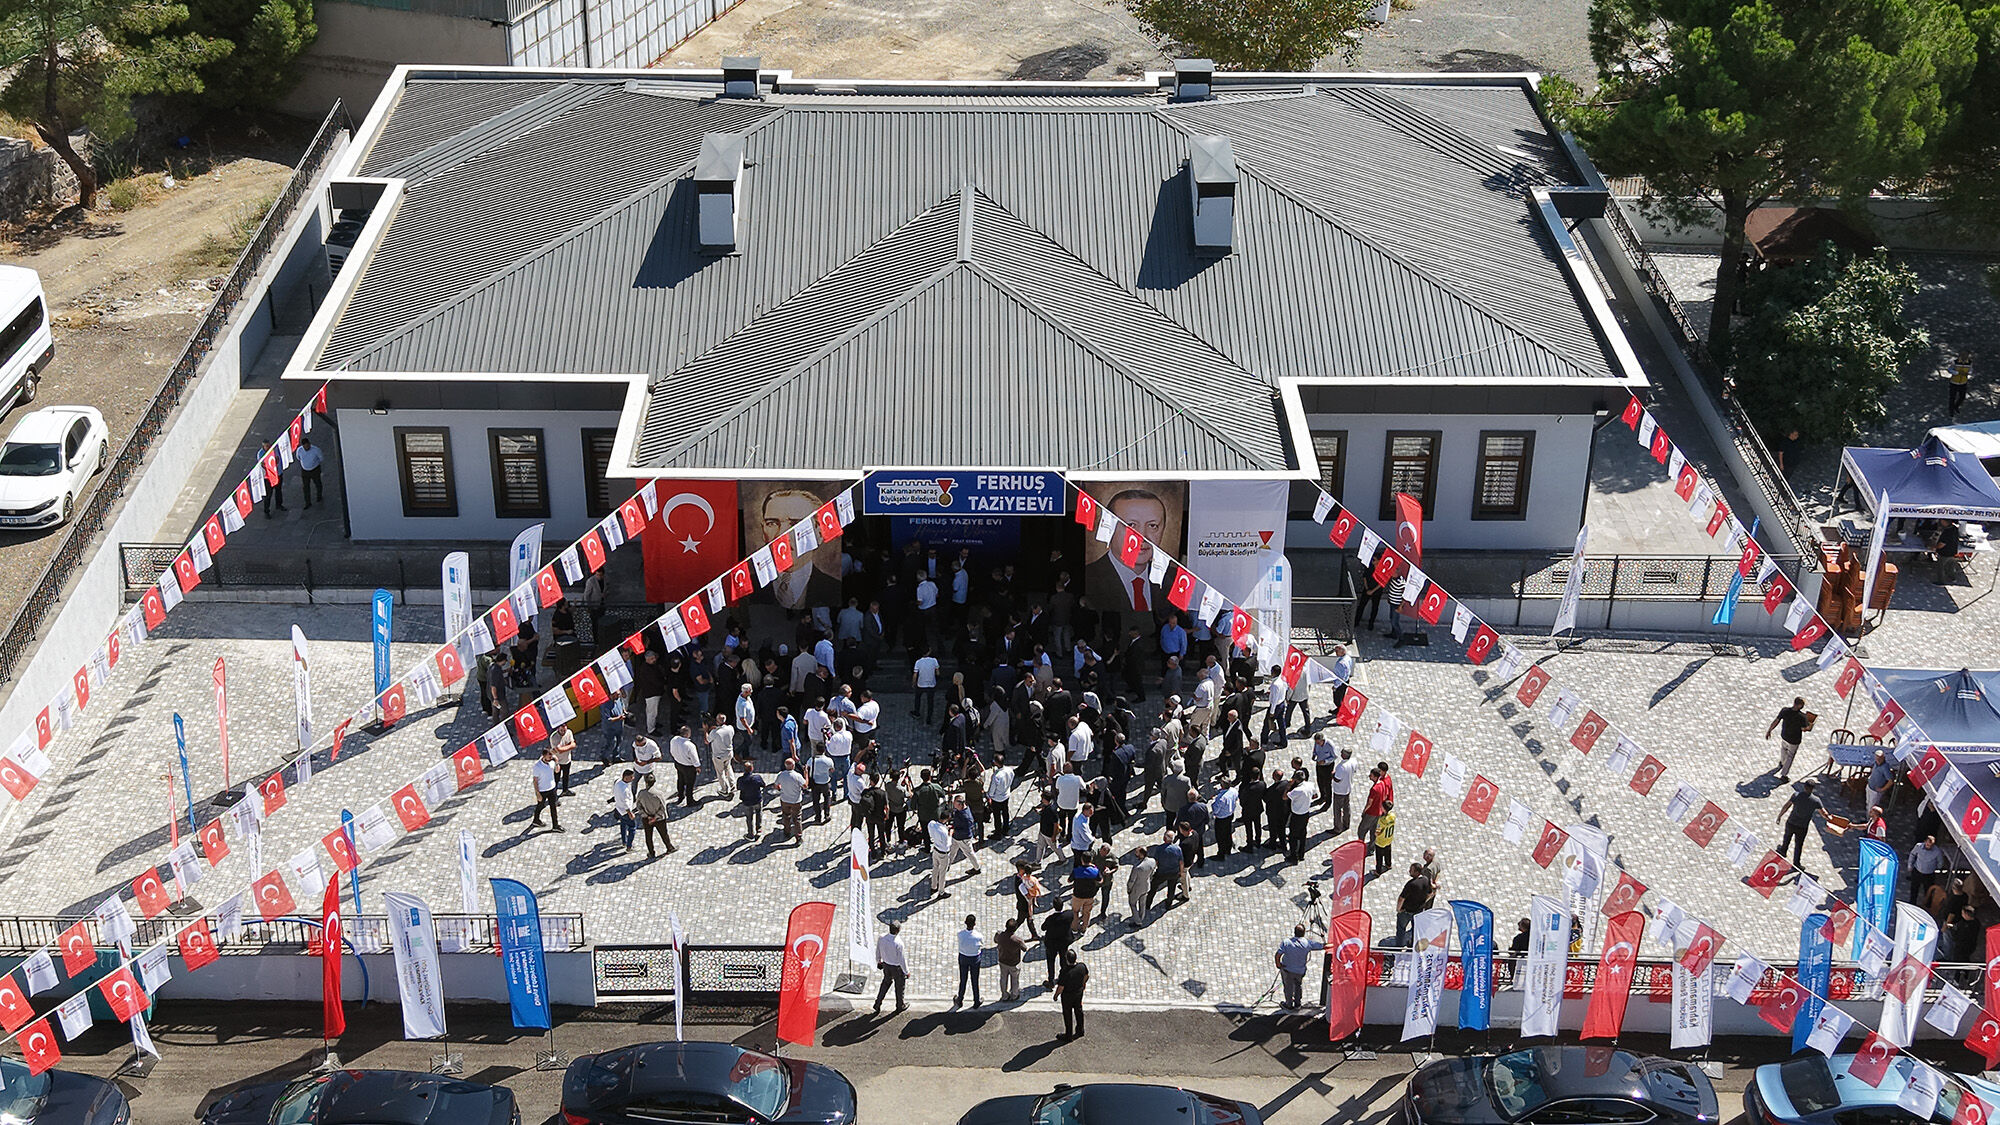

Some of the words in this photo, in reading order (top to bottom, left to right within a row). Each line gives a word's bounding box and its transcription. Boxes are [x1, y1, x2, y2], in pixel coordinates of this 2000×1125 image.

[977, 475, 1045, 494] FERHUŞ
[881, 488, 938, 496] Kahramanmaraş
[909, 518, 947, 526] FERHUŞ
[1385, 825, 1394, 838] 10
